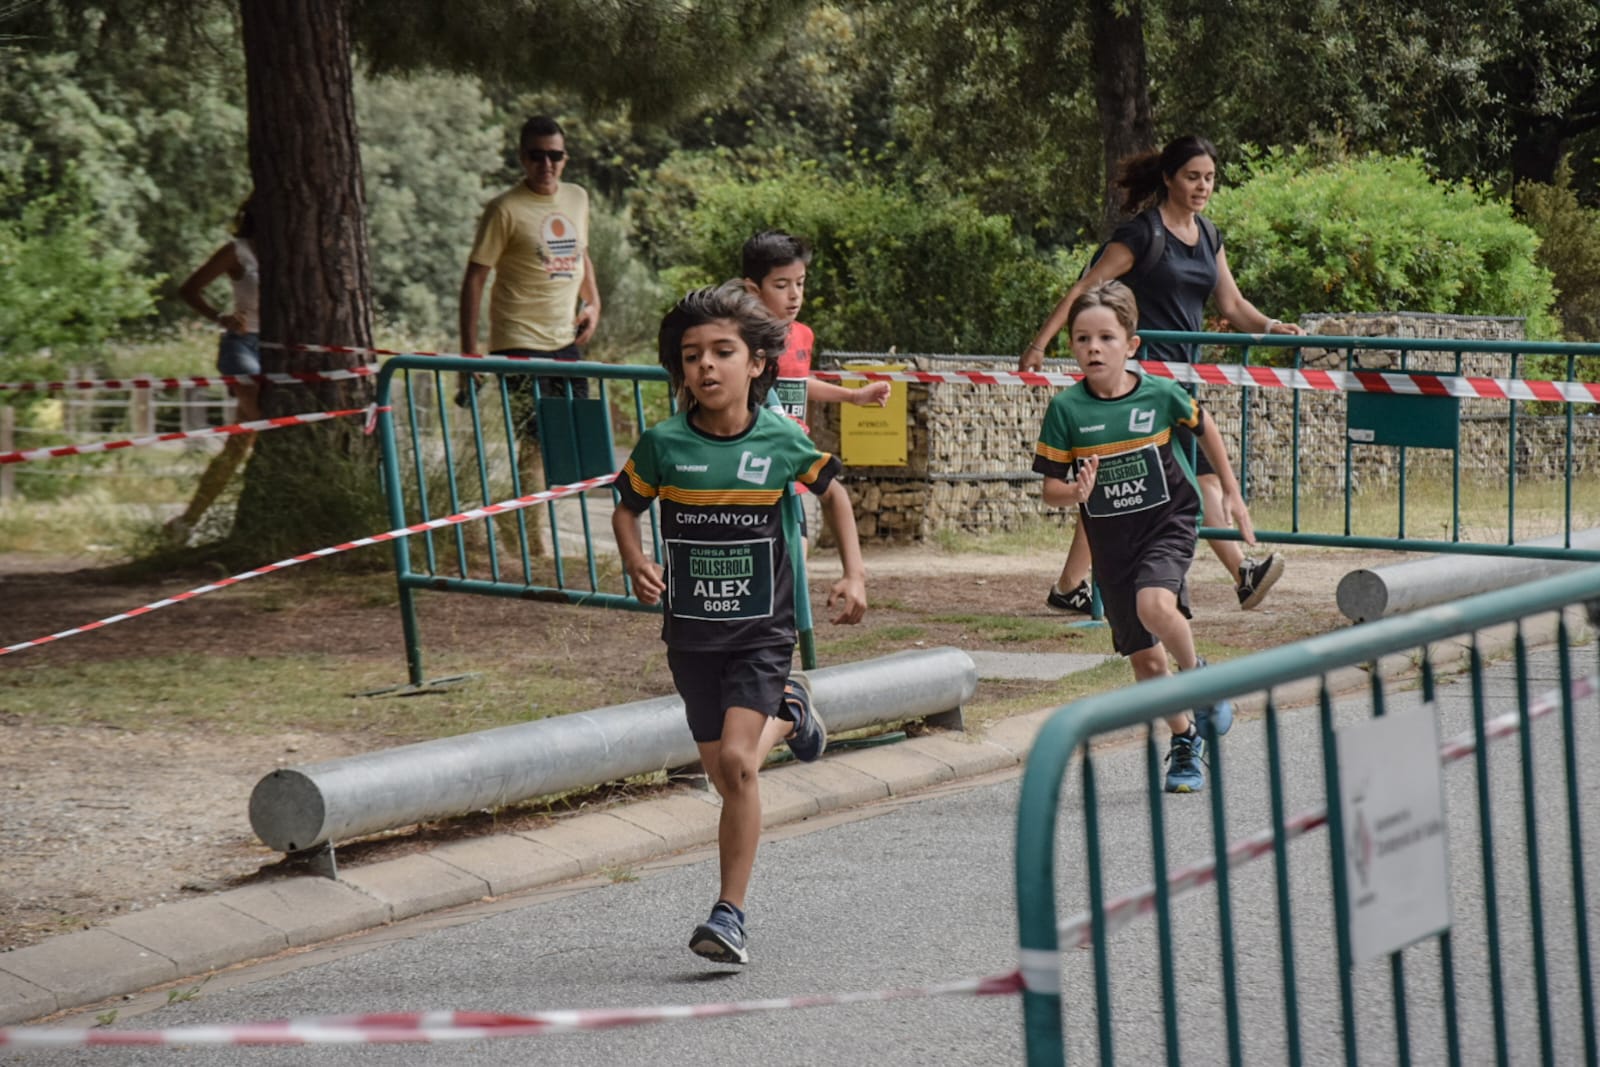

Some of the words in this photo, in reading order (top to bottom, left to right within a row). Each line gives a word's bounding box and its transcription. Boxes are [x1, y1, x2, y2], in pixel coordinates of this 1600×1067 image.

[1103, 478, 1147, 499] MAX
[1113, 495, 1143, 508] 6066
[690, 548, 725, 556] CURSA
[691, 558, 751, 576] COLLSEROLA
[693, 579, 751, 597] ALEX
[703, 600, 740, 611] 6082
